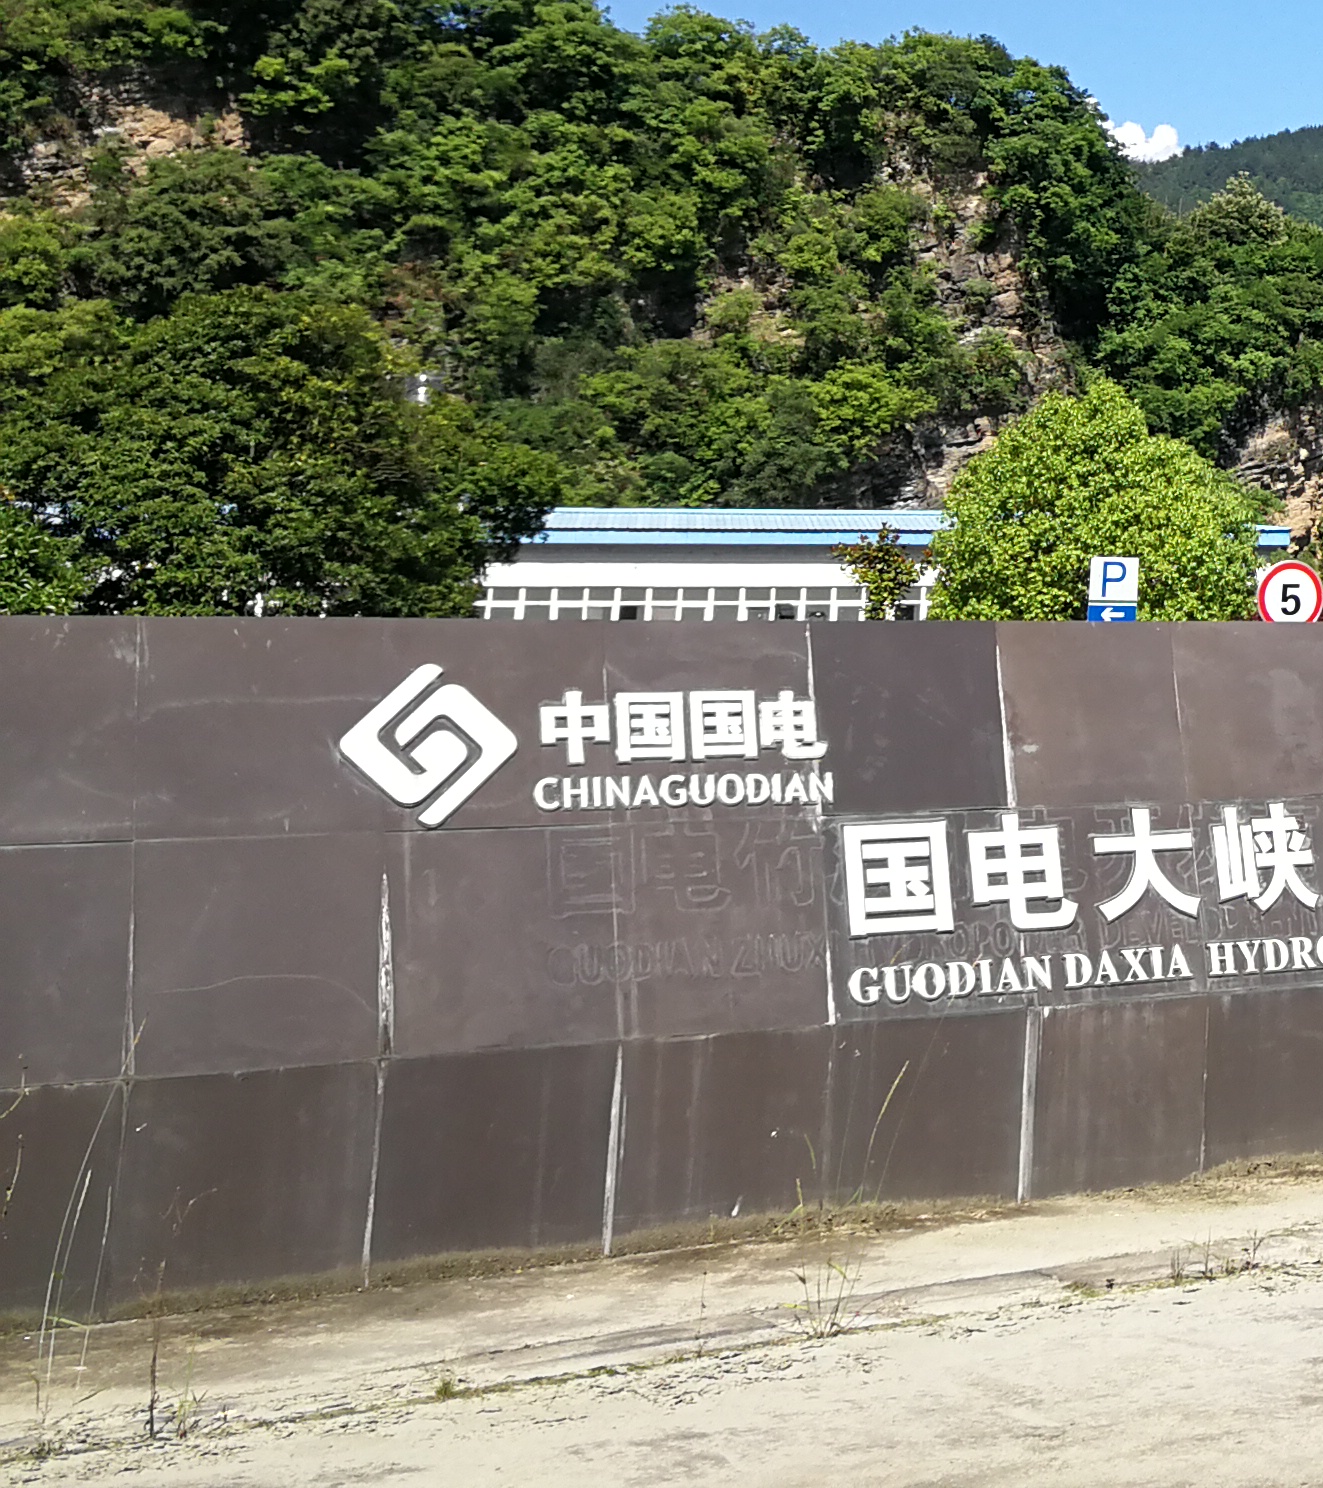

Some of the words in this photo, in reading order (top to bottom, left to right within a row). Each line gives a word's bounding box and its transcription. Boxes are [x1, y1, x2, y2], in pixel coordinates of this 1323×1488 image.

[1102, 562, 1127, 597] P
[1281, 584, 1301, 616] 5
[539, 689, 828, 765] 中国国电
[532, 771, 833, 811] CHINAGUODIAN
[848, 953, 1053, 1005] GUODIAN
[1063, 943, 1194, 988] DAXIA
